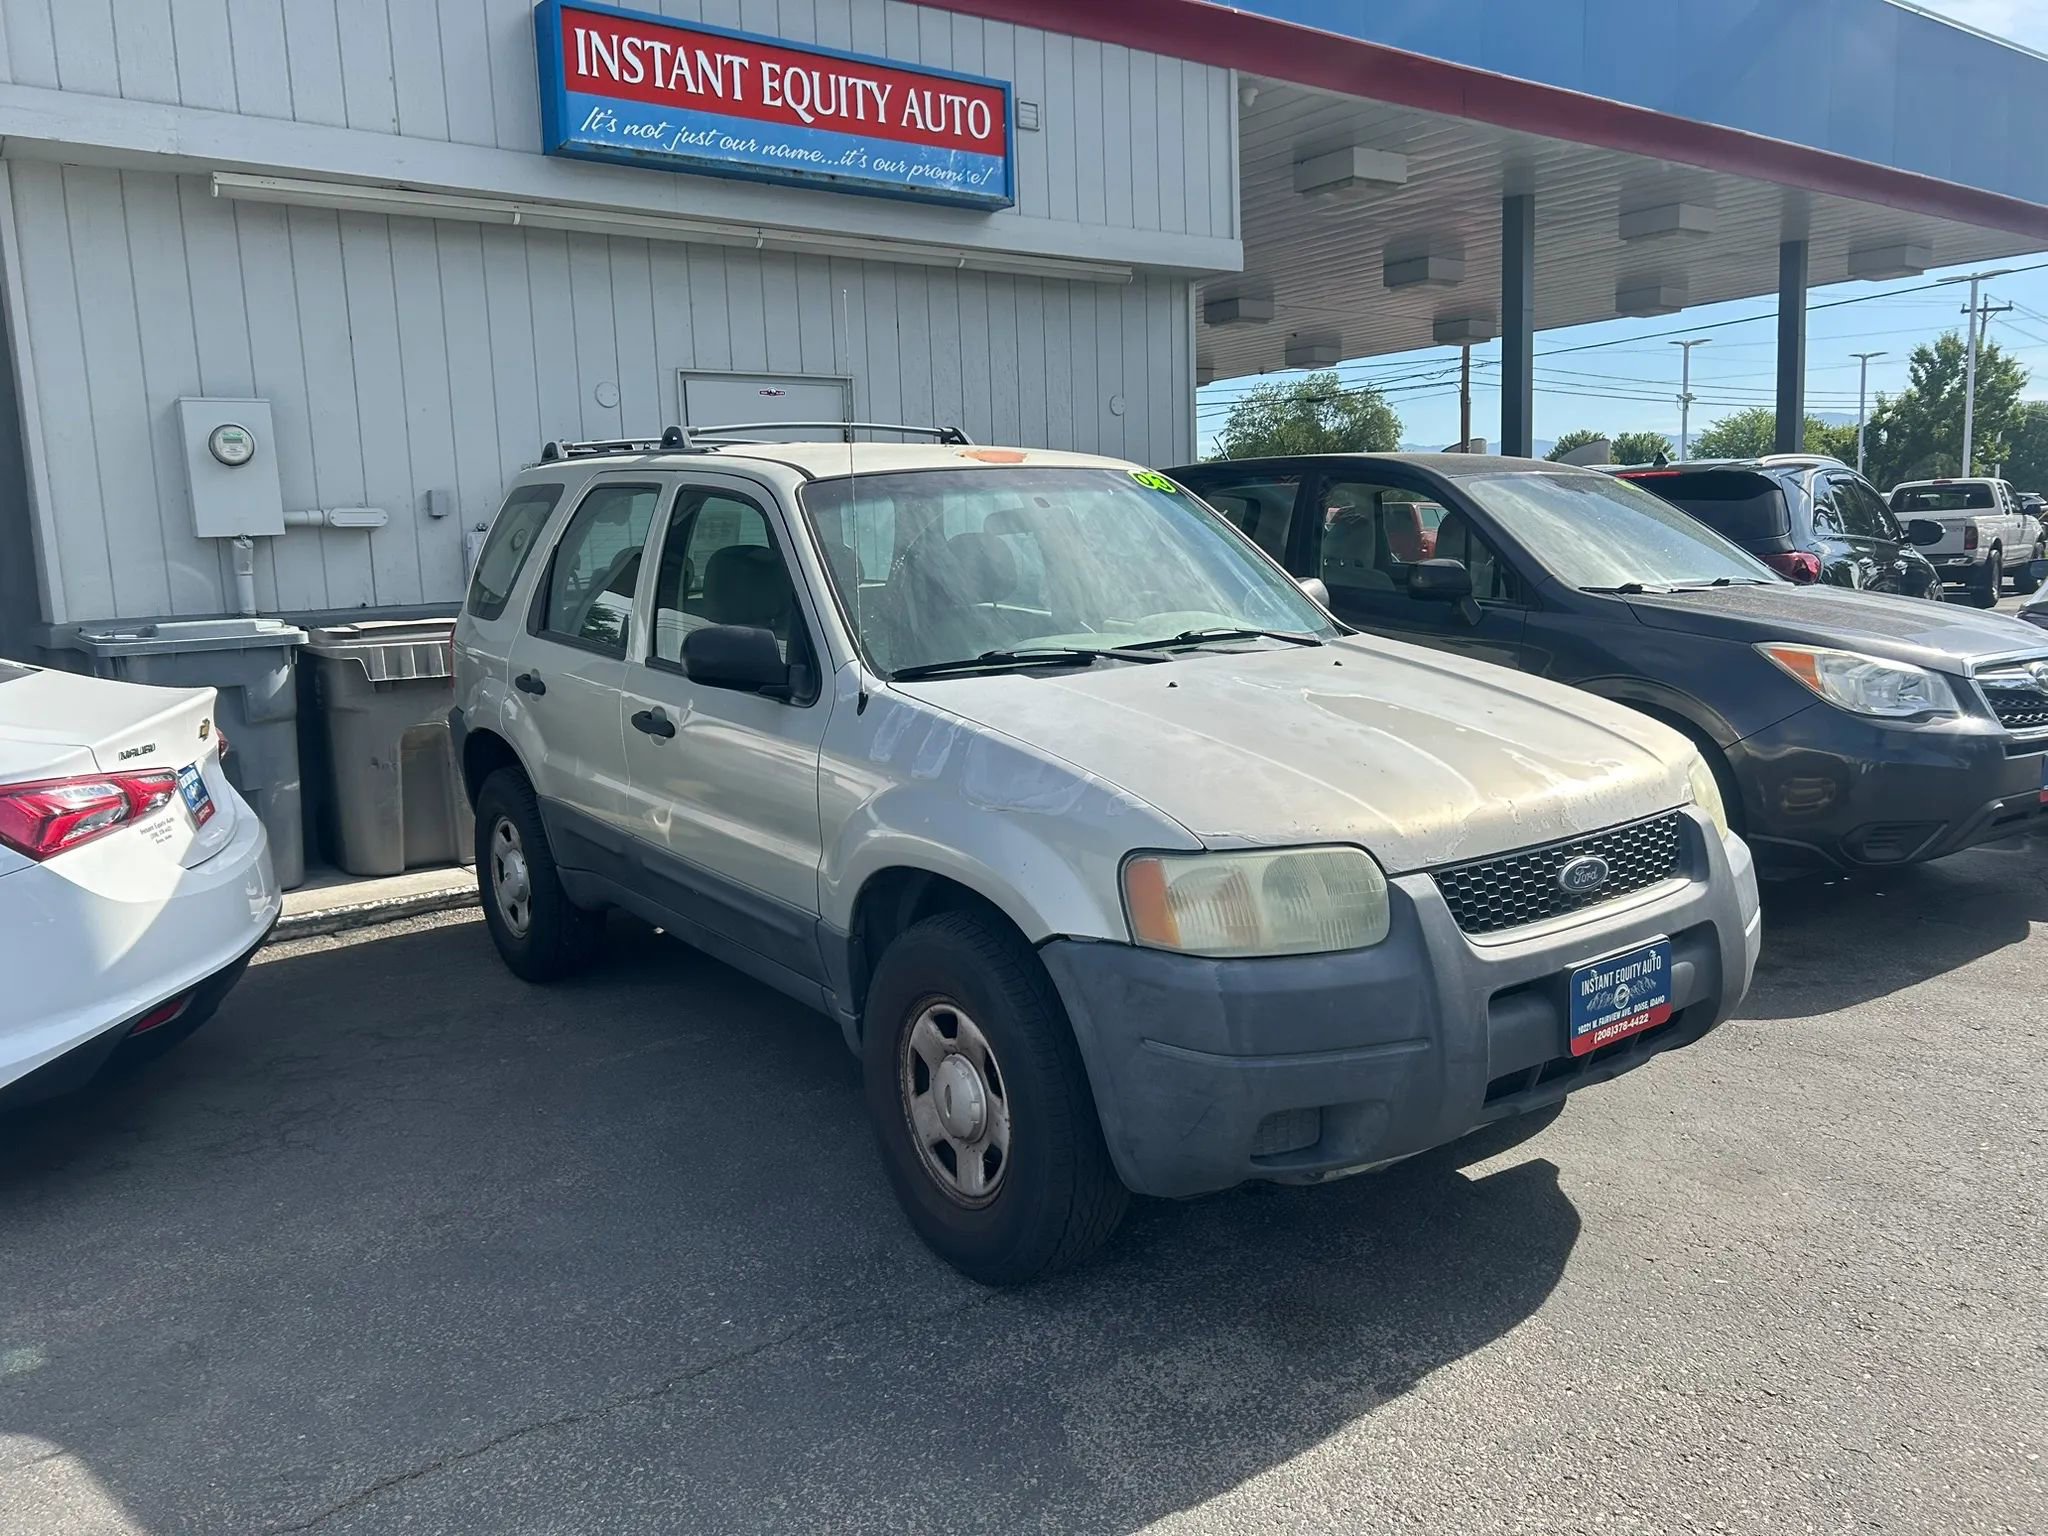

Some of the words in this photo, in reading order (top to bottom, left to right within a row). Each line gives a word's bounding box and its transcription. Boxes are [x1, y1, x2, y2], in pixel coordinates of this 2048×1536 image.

[575, 27, 749, 102] INSTANT
[761, 60, 892, 124] EQUITY
[901, 87, 992, 140] AUTO
[580, 106, 618, 133] It's
[623, 121, 674, 140] not
[662, 126, 723, 151] just
[719, 136, 759, 153] our
[873, 156, 909, 174] our
[1573, 864, 1598, 885] Ford
[1581, 971, 1614, 997] INSTANT
[1615, 962, 1641, 984] EQUITY
[1642, 955, 1662, 974] AUTO
[1593, 1013, 1649, 1044] (208)378-4422
[1598, 1011, 1622, 1027] FAIRVIEW
[1650, 994, 1665, 1007] IDAHO
